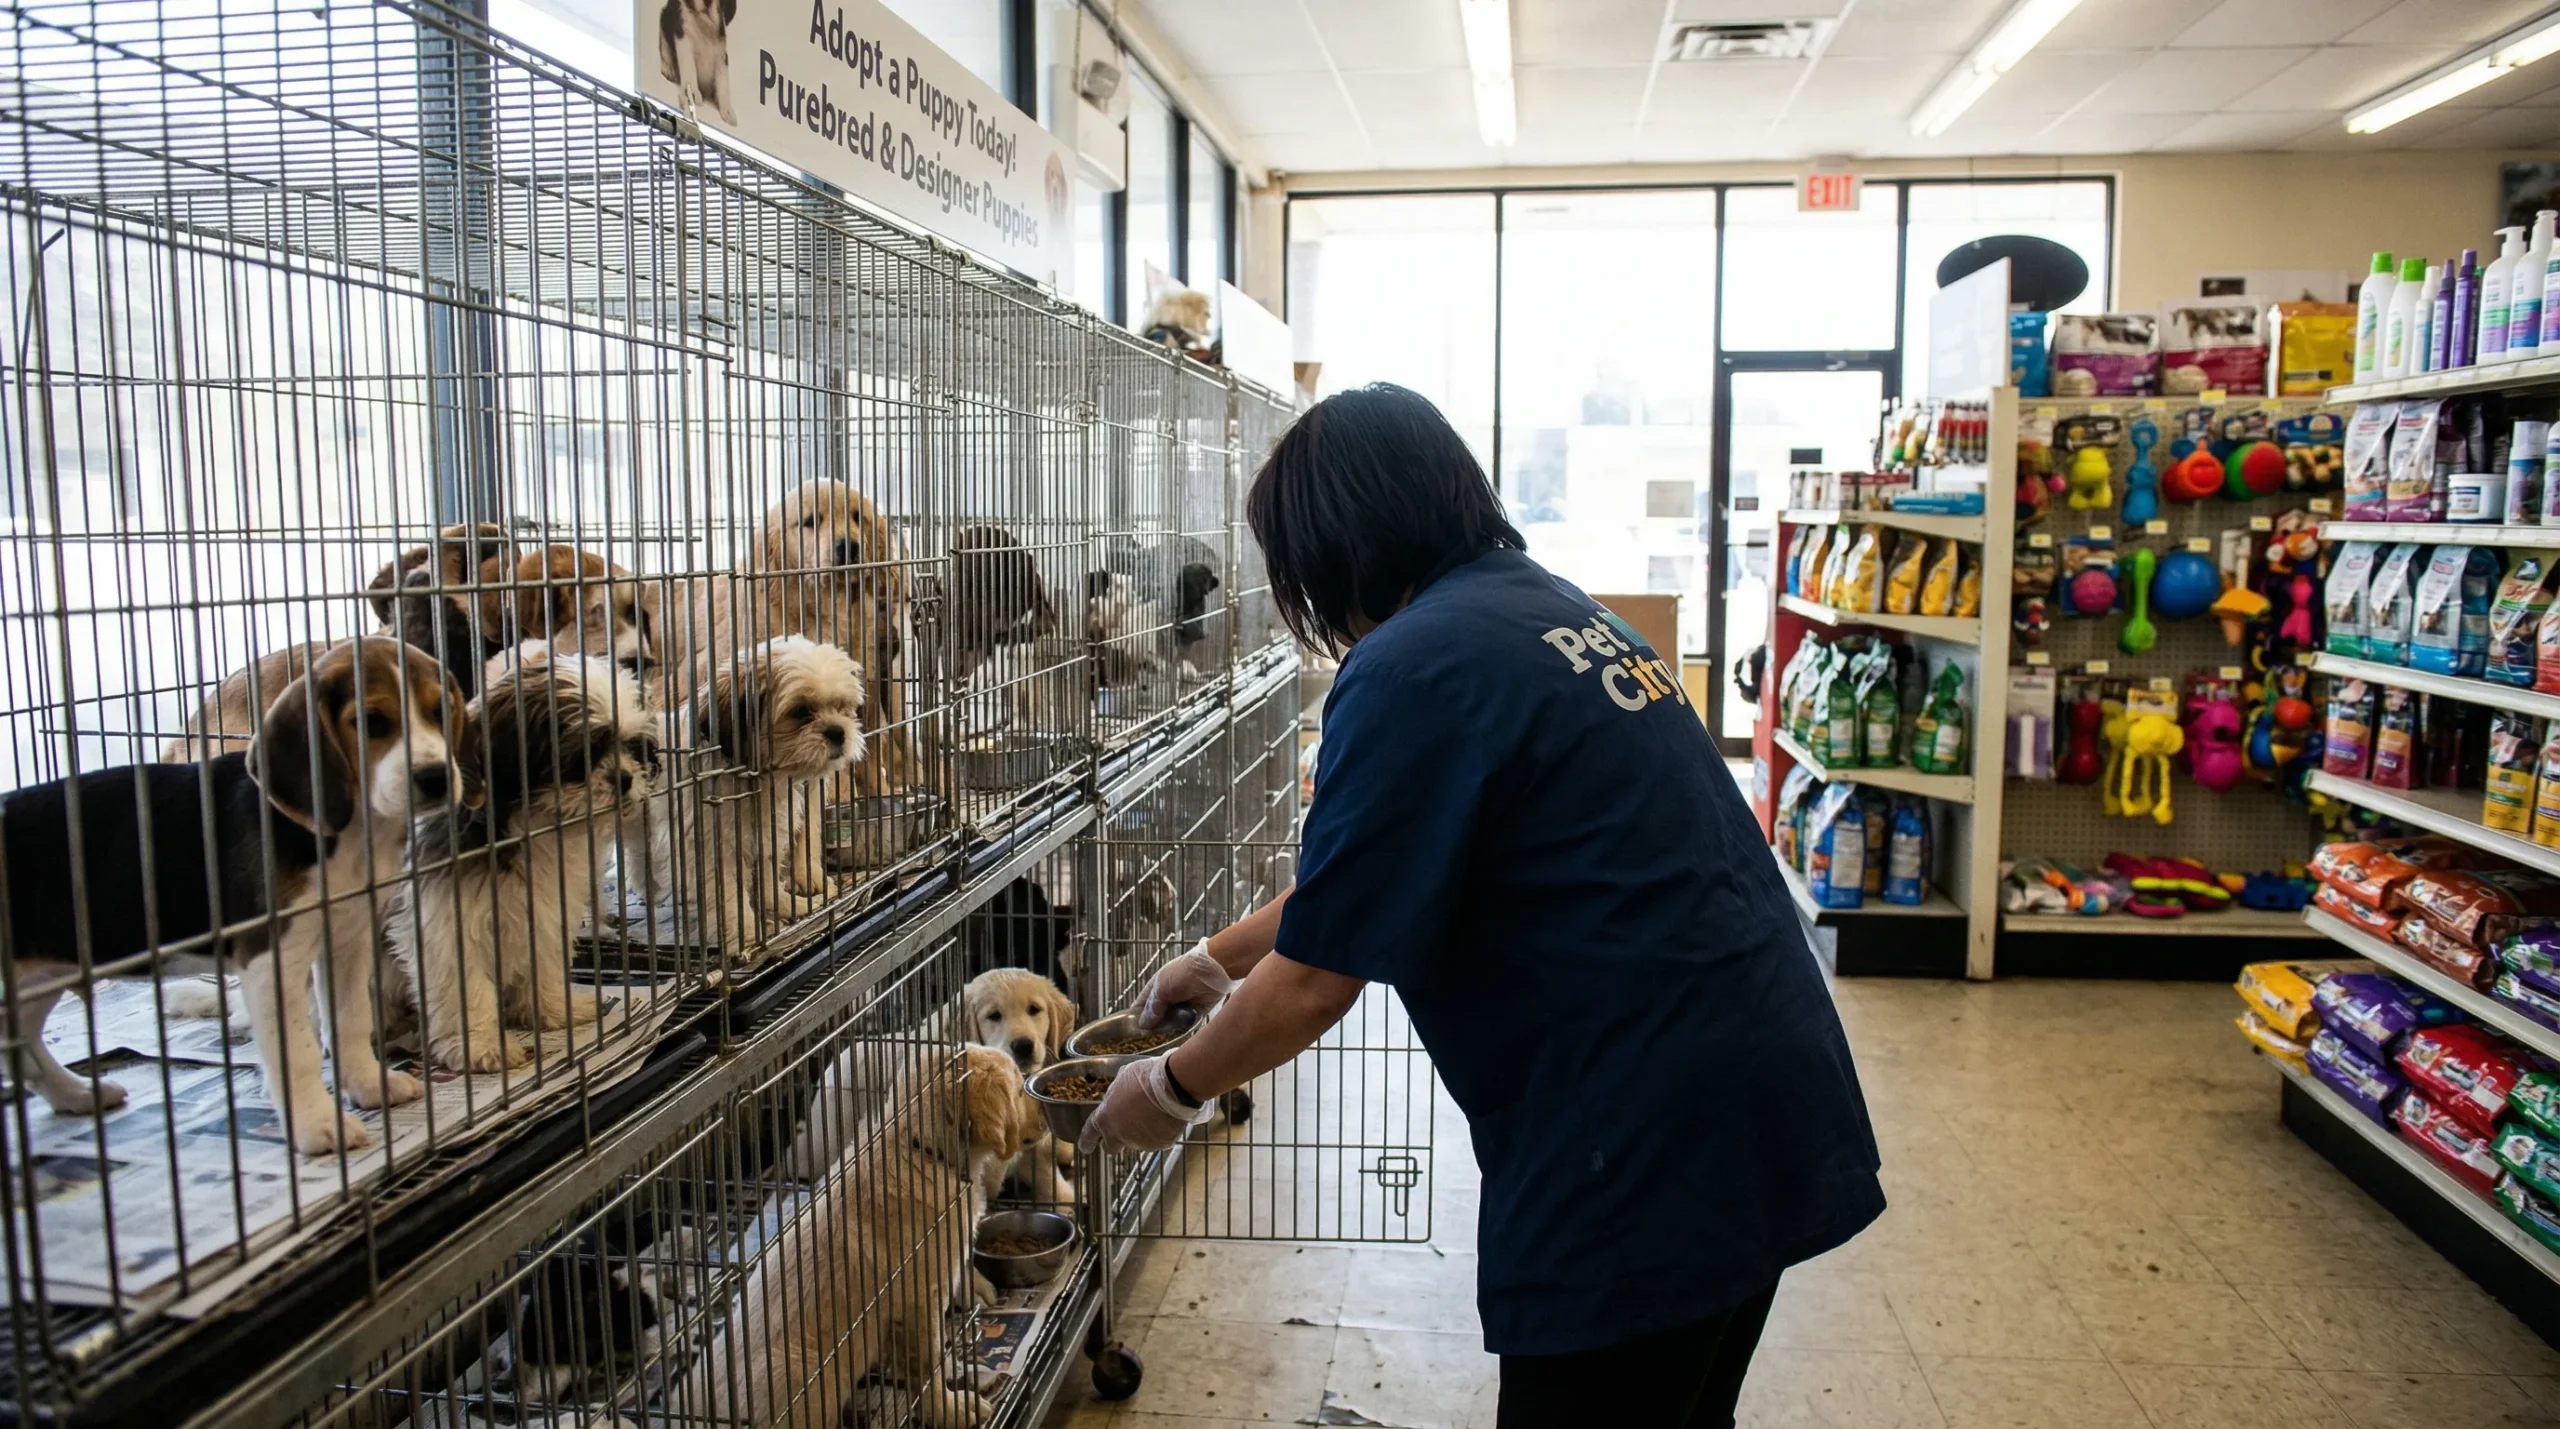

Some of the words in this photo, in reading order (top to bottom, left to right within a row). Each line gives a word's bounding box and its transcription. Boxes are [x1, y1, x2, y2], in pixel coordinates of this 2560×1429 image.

[809, 0, 883, 89] Adopt
[889, 58, 900, 98] a
[906, 57, 964, 147] Puppy
[967, 99, 1016, 179] Today!
[759, 49, 874, 162] Purebred
[880, 121, 896, 174] &
[901, 132, 979, 216] Designer
[983, 181, 1038, 248] Puppies
[1807, 175, 1853, 208] EXIT
[1541, 617, 1631, 675] Pet
[1602, 654, 1686, 712] City
